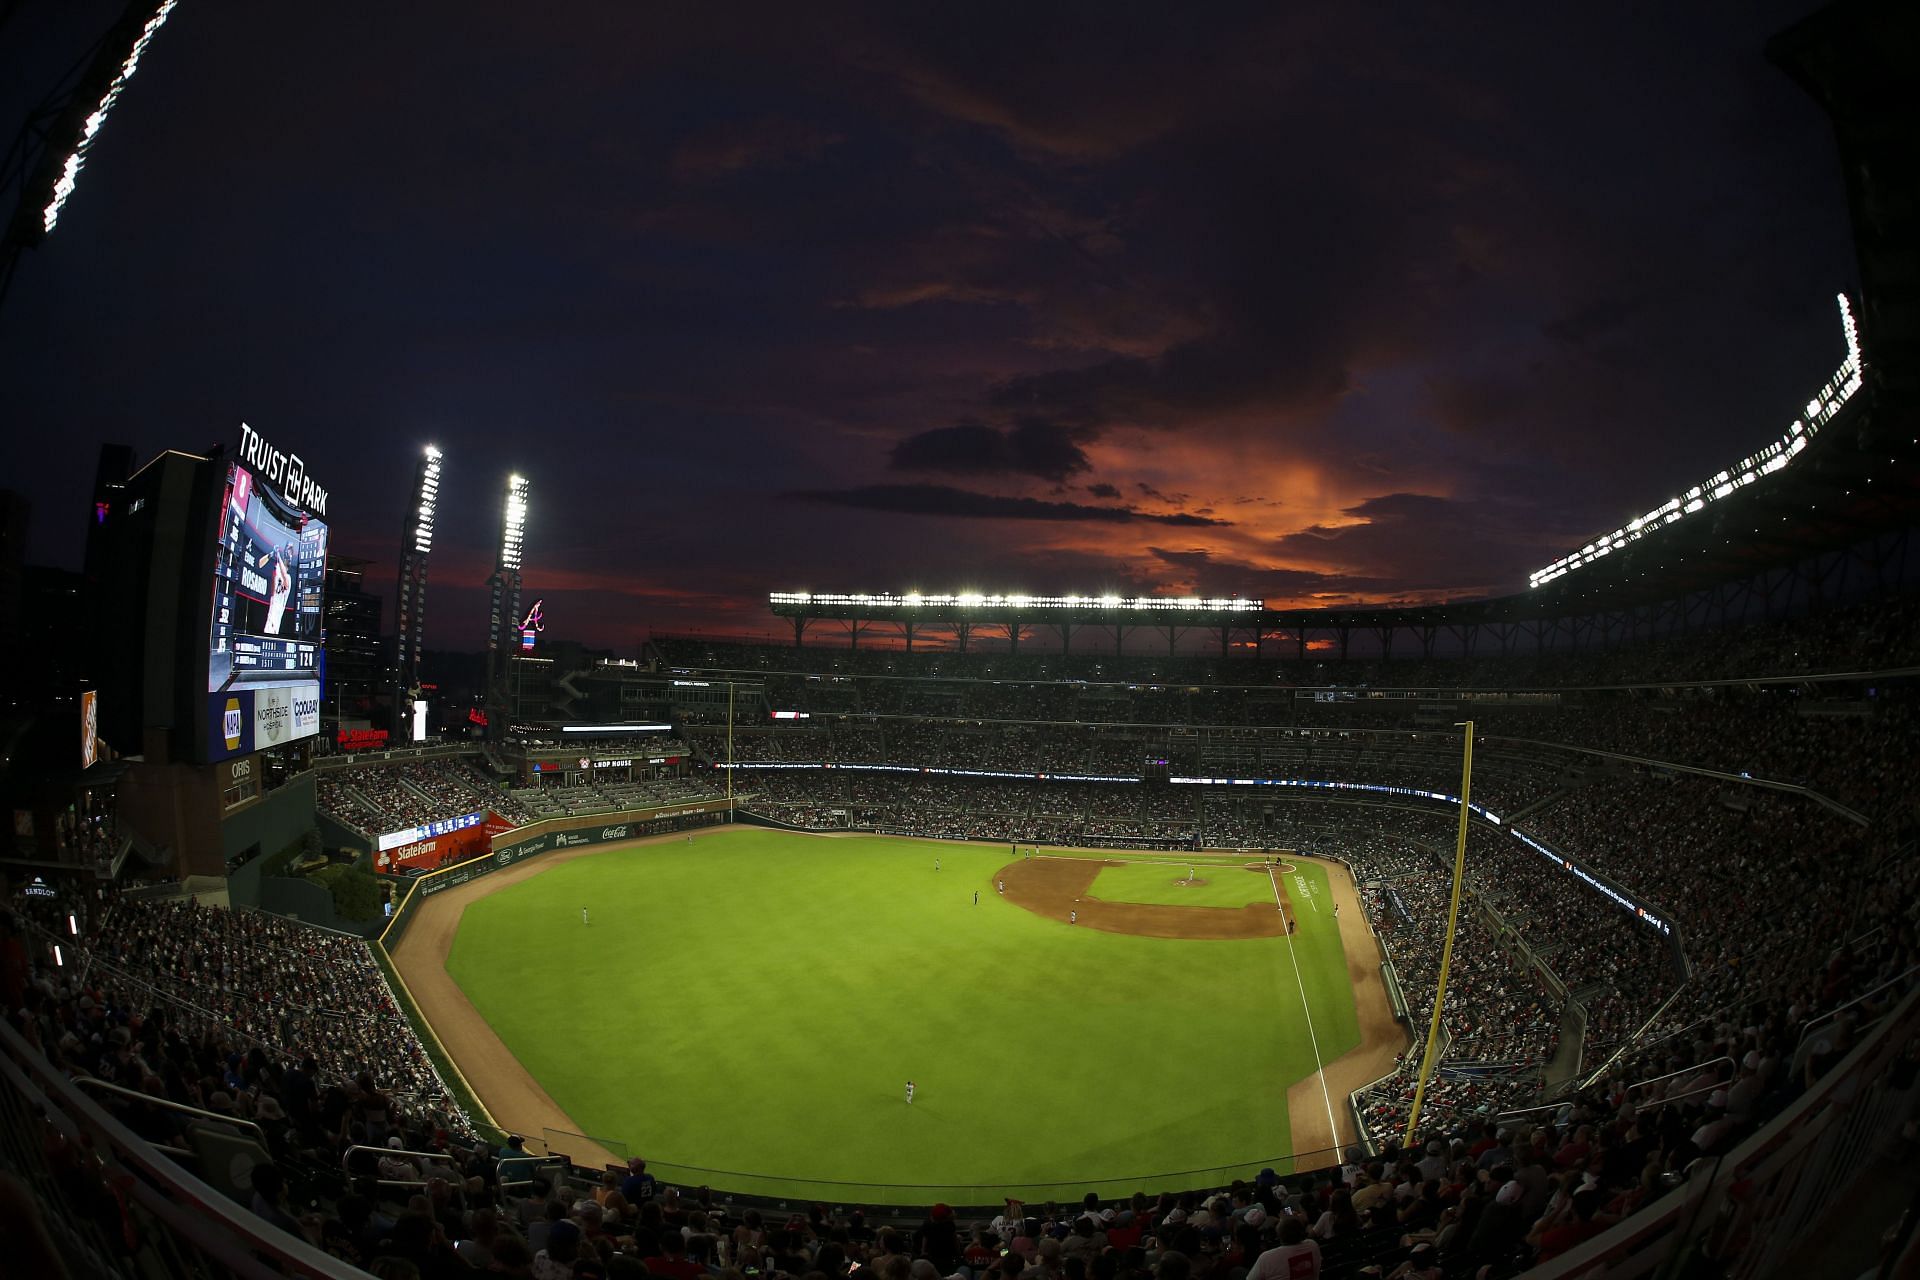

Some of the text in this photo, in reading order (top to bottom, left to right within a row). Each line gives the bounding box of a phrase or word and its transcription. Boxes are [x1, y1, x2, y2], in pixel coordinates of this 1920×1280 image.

[240, 422, 328, 516] TRUIST PARK
[239, 474, 247, 498] 8
[241, 566, 267, 595] ROSARIO
[258, 706, 289, 720] NORTHSIDE
[294, 699, 319, 716] COOLRAY
[226, 711, 240, 736] NAPA
[232, 759, 250, 777] ORIS
[641, 1186, 652, 1198] 23
